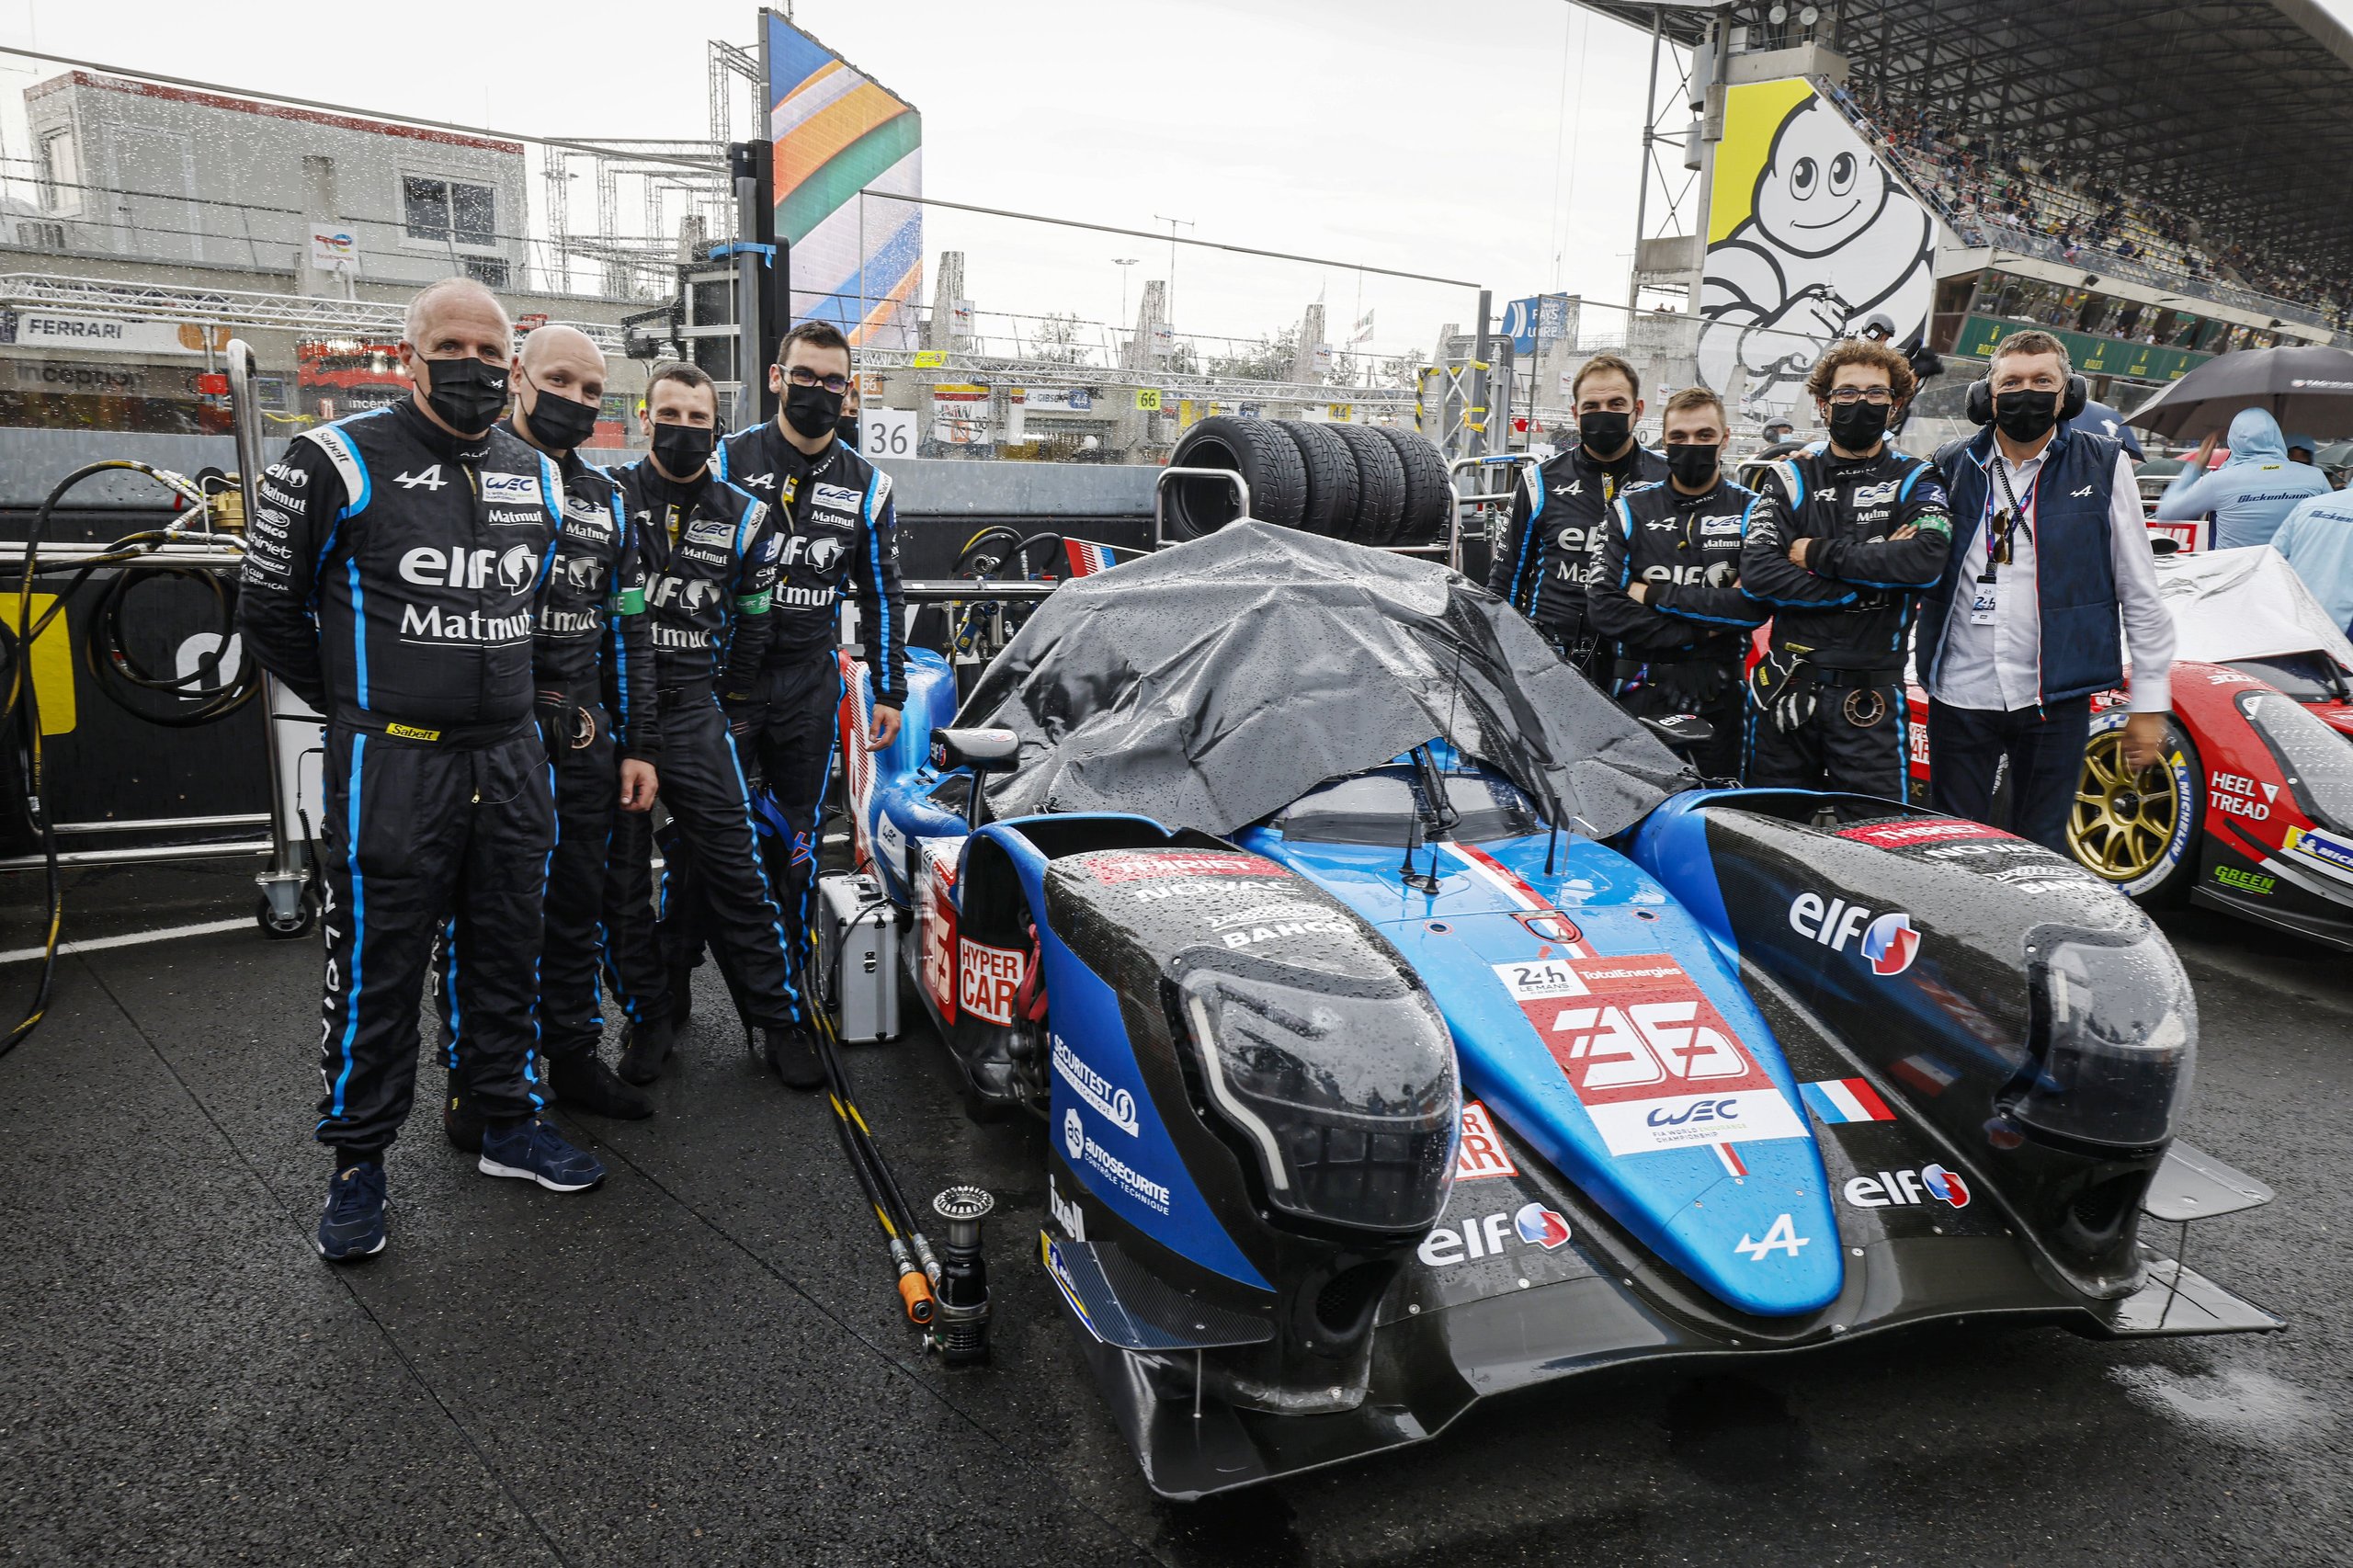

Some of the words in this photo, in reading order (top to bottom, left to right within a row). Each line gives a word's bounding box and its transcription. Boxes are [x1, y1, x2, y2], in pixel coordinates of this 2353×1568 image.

[1532, 309, 1559, 321] PAYS
[29, 318, 124, 340] FERRARI
[1527, 326, 1559, 338] LOIRE
[1140, 392, 1156, 408] 66
[315, 432, 351, 463] Sabelt
[870, 423, 908, 455] 36
[486, 477, 533, 492] WEC
[816, 486, 860, 503] WEC
[488, 509, 543, 523] Matmut
[691, 522, 732, 537] WEC
[812, 510, 856, 529] Matmut
[779, 531, 809, 565] lf
[1557, 526, 1599, 552] el
[399, 546, 496, 589] elf
[681, 545, 729, 565] Matmut
[644, 572, 683, 608] lf
[776, 580, 837, 607] tmut
[400, 603, 533, 641] Matmut
[540, 604, 598, 631] tmut
[651, 621, 710, 649] tmut
[392, 724, 434, 740] Sabelt
[2211, 771, 2256, 798] HEEL
[2170, 781, 2192, 858] MICHELIN
[2210, 791, 2270, 822] TREAD
[1109, 858, 1252, 874] THIRIET
[2214, 865, 2276, 892] GREEN
[1222, 920, 1355, 949] BAHCO
[1790, 892, 1871, 952] elf
[962, 942, 1018, 980] HYPER
[1513, 966, 1566, 985] 24h
[1578, 966, 1683, 981] TotalEnergies
[1536, 983, 1570, 991] MANS
[963, 968, 1017, 1017] CAR
[1552, 1001, 1750, 1091] 36
[1054, 1034, 1113, 1101] SECURITEST
[1647, 1099, 1739, 1128] WEC
[1655, 1131, 1719, 1143] CHAMPIONSHIP
[1668, 1127, 1698, 1137] WORLD
[1699, 1122, 1748, 1132] ENDURANCE
[1120, 1181, 1170, 1216] TECHNIQUE
[1844, 1169, 1924, 1208] elf
[1417, 1212, 1512, 1267] elf
